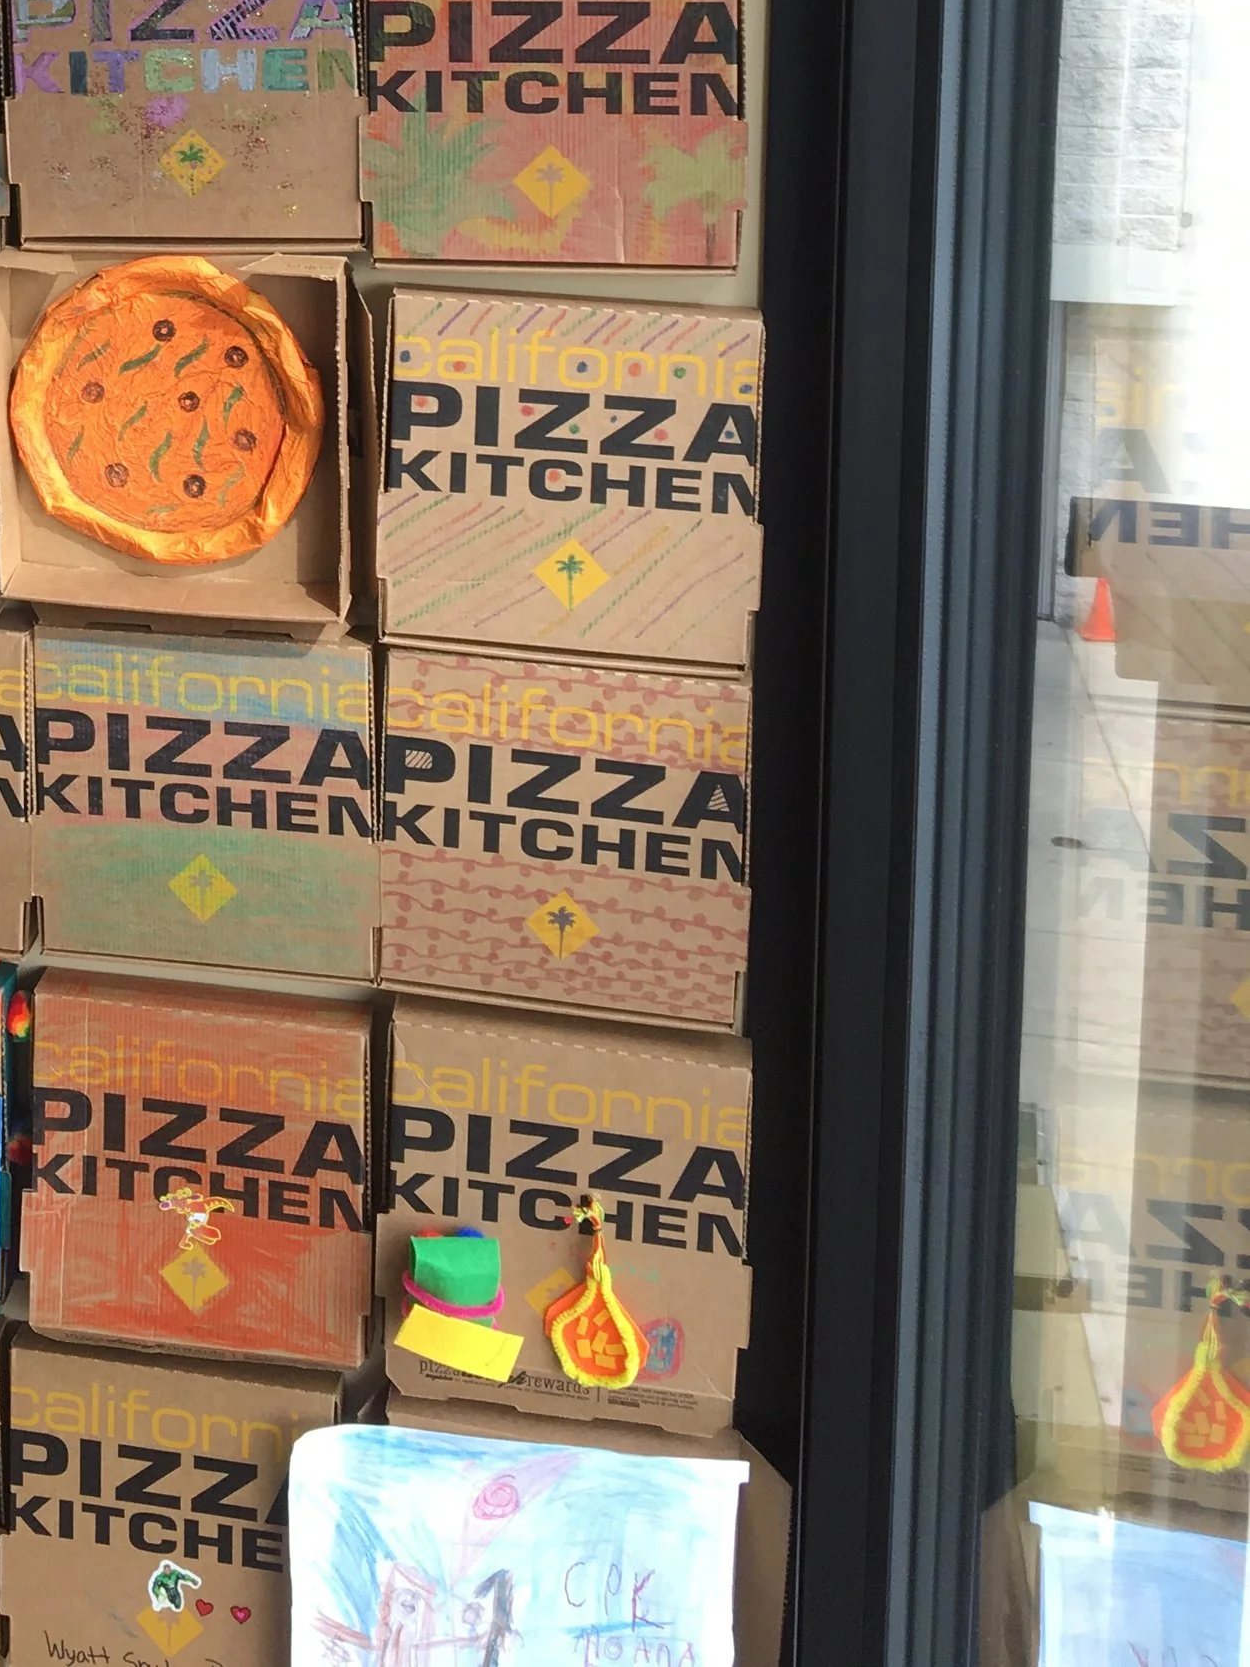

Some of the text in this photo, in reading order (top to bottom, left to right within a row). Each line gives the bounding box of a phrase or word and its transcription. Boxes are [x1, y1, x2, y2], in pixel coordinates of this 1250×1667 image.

[15, 46, 354, 97] KITCHEN
[368, 0, 737, 66] PIZZA
[368, 69, 737, 119] KITCHEN
[393, 325, 758, 404] california
[391, 380, 756, 467] PIZZA
[389, 446, 756, 518] KITCHEN
[36, 651, 370, 726] california
[387, 684, 745, 768] california
[36, 706, 371, 791] PIZZA
[382, 732, 747, 835] PIZZA
[36, 772, 376, 840] KITCHEN
[382, 803, 747, 884] KITCHEN
[34, 1031, 364, 1120] california
[393, 1054, 749, 1149] california
[32, 1085, 364, 1187] PIZZA
[391, 1104, 745, 1211] PIZZA
[32, 1151, 366, 1232] KITCHEN
[391, 1169, 744, 1258] KITCHEN
[11, 1382, 300, 1461] californ
[526, 1374, 591, 1395] rewards
[10, 1428, 289, 1526] PIZZ
[10, 1492, 284, 1574] KITCHE
[43, 1629, 111, 1666] Wyatt
